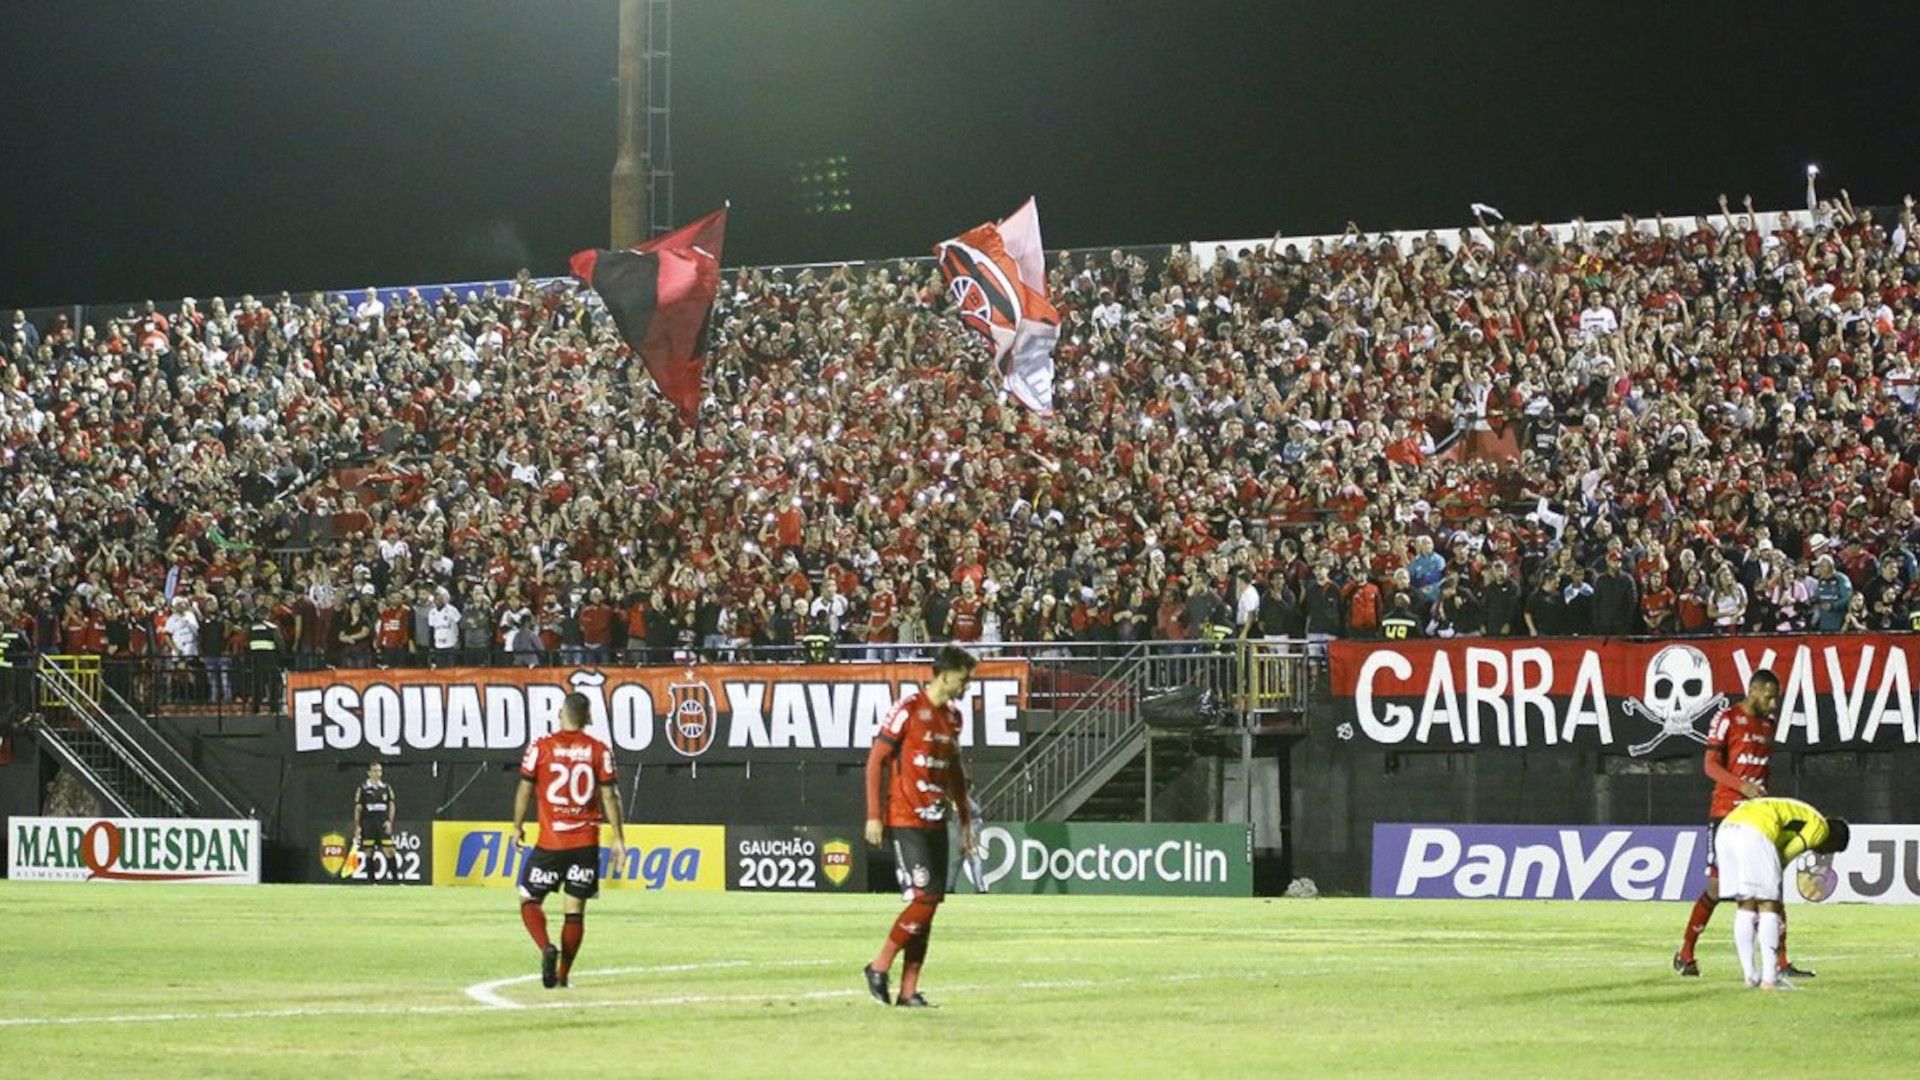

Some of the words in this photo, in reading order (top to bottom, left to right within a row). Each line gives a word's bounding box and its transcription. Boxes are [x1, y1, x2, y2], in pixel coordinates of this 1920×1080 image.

[725, 680, 1020, 748] XAVATE
[1355, 647, 1613, 747] GARRA
[1733, 644, 1920, 745] AVA
[546, 763, 595, 806] 20
[16, 821, 249, 882] MARQUESPAN
[739, 838, 816, 857] GAUCHÃO
[739, 858, 816, 888] 2022
[1021, 839, 1228, 883] DoctorClin
[1395, 828, 1698, 901] PanVel
